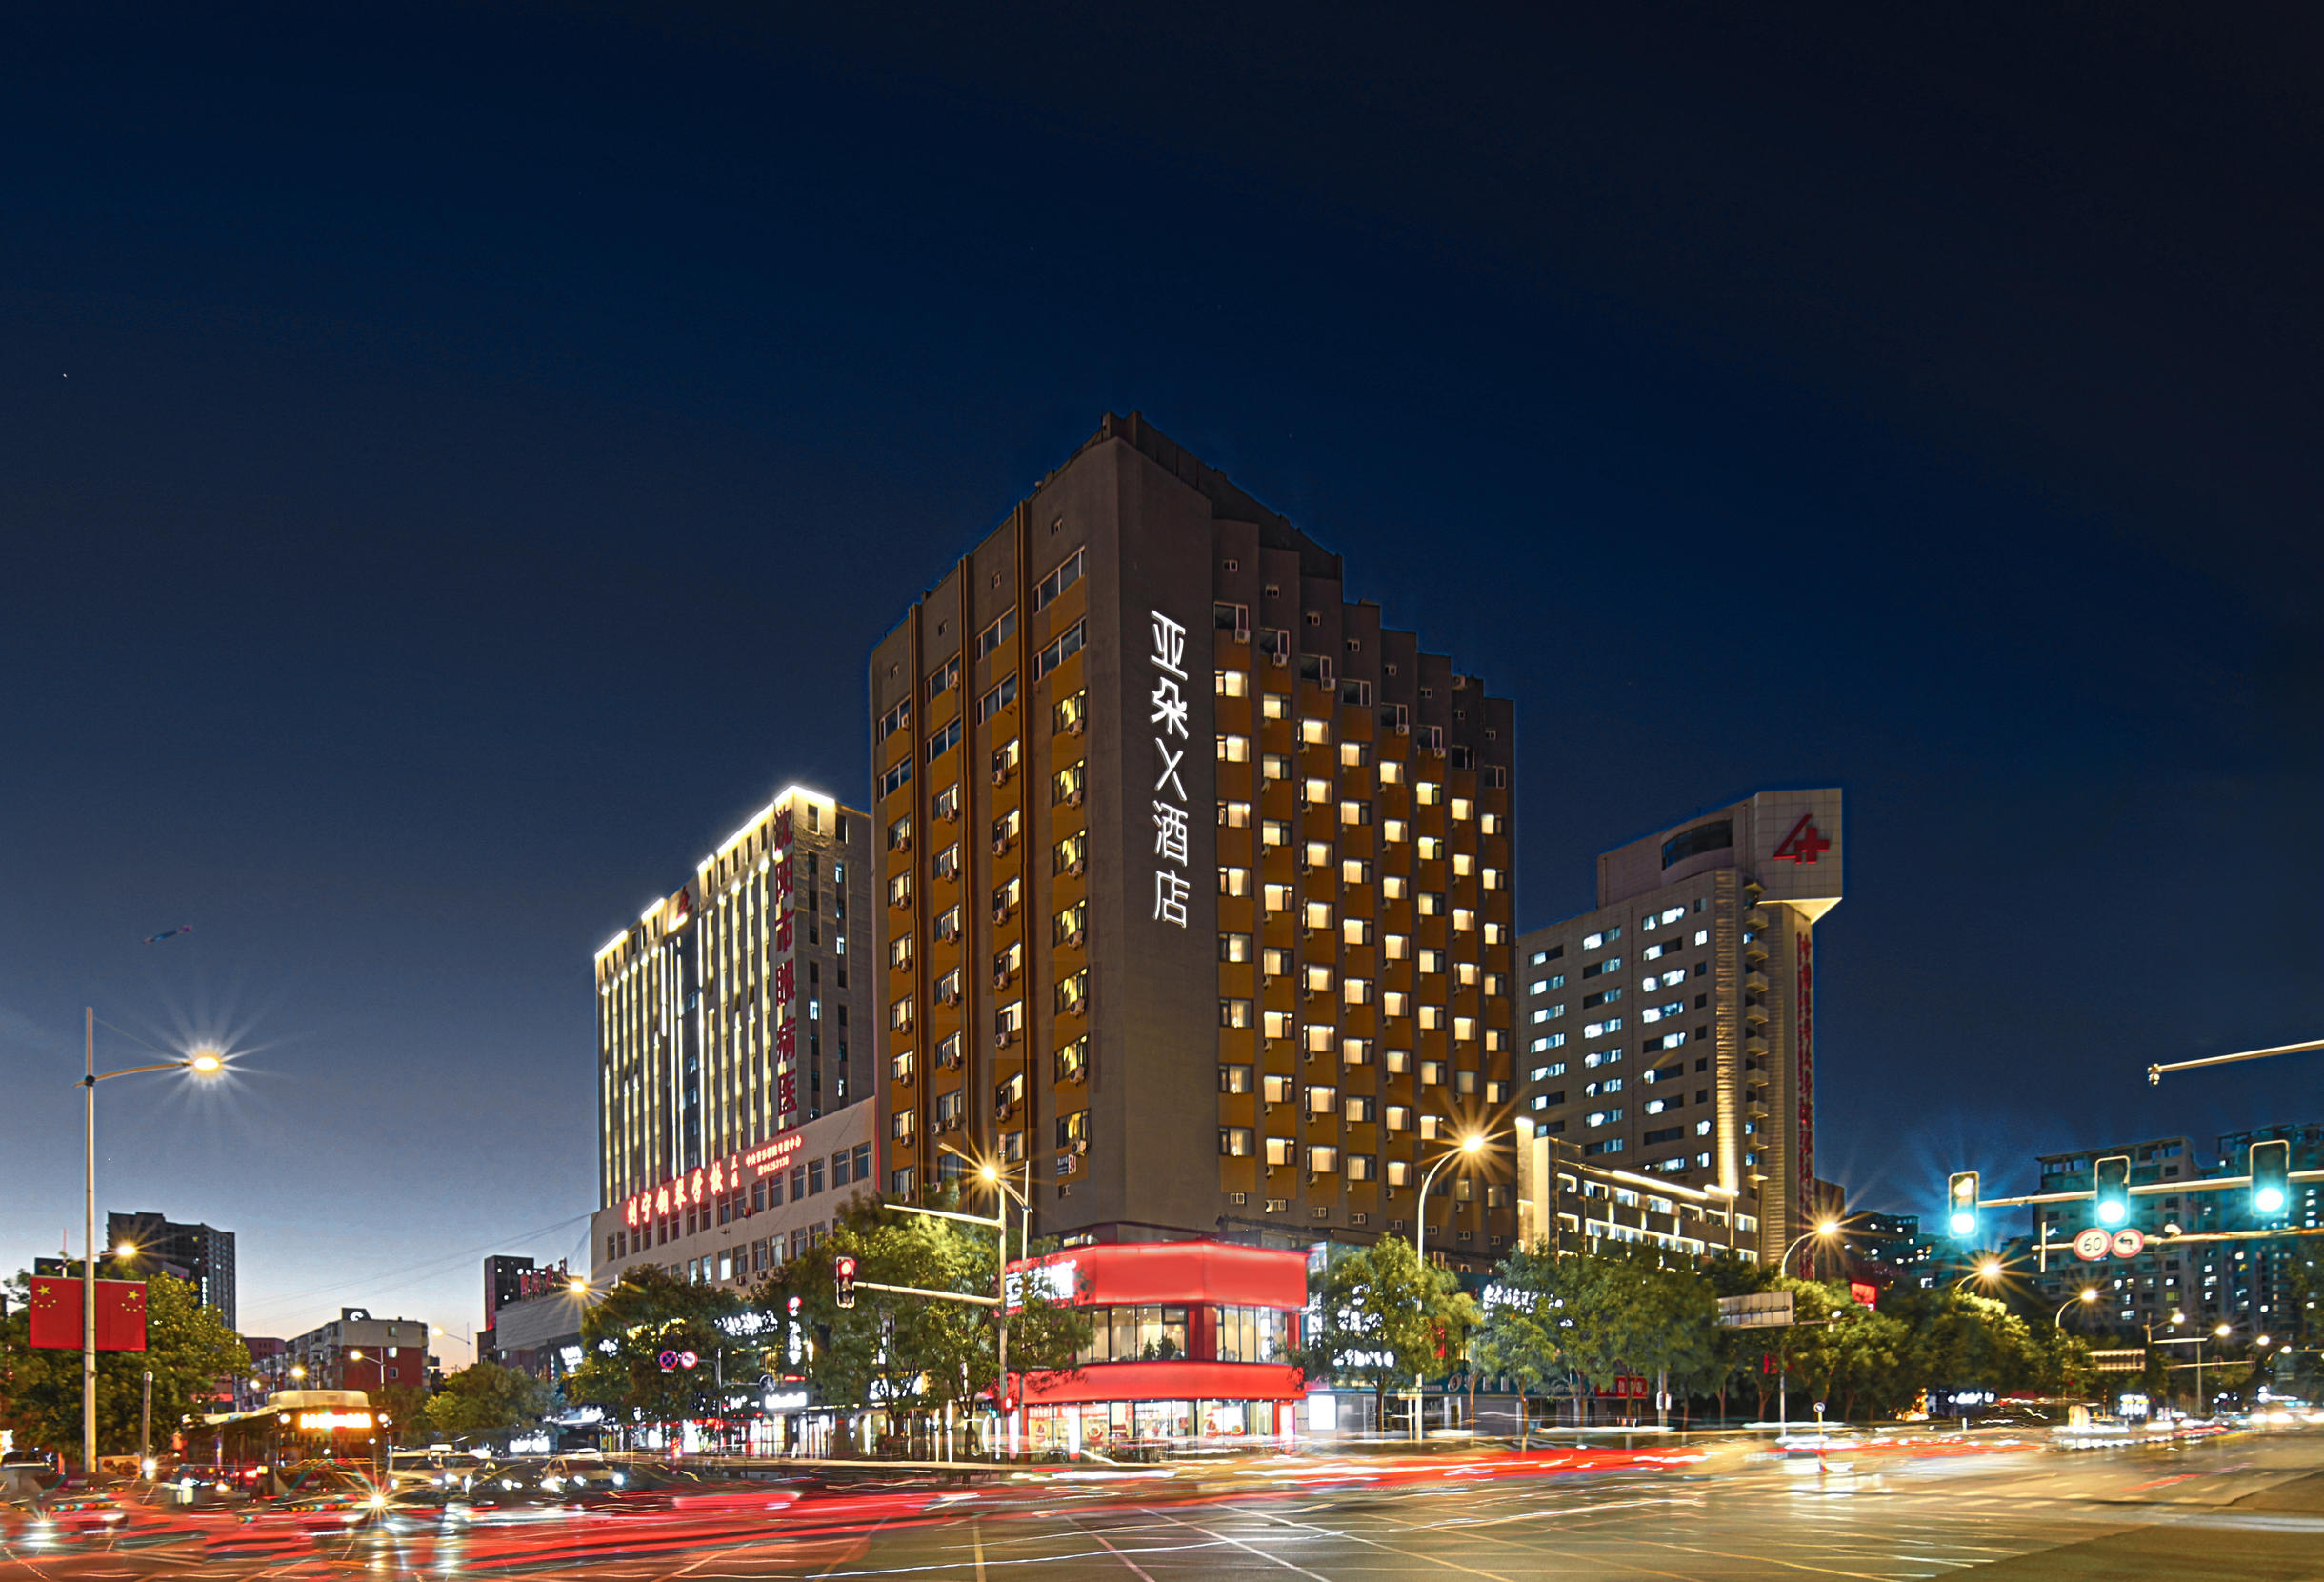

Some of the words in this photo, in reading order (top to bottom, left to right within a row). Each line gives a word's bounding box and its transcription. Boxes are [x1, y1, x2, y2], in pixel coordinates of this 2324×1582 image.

[773, 806, 797, 1135] 沈阳市眼病医
[2084, 1237, 2102, 1251] 60
